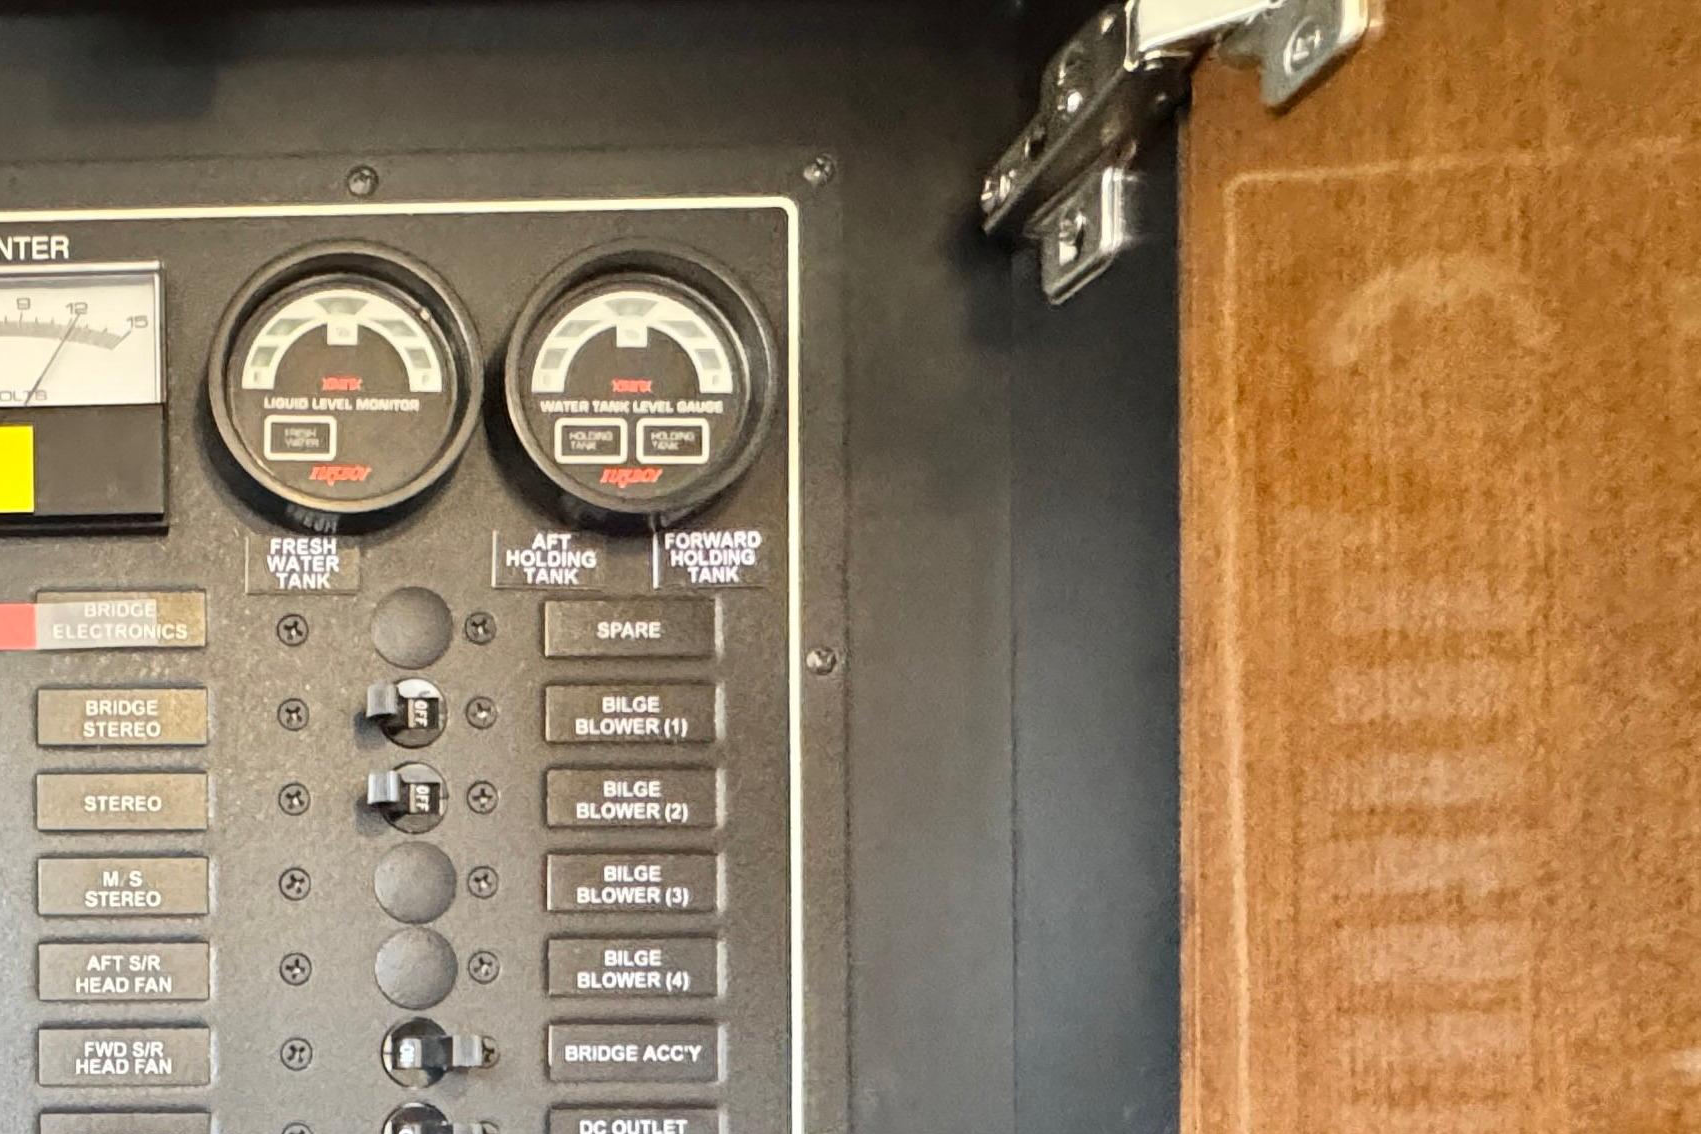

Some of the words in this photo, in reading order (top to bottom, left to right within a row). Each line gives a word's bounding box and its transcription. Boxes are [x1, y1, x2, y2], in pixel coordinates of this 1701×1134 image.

[16, 297, 31, 311] 9
[66, 302, 89, 316] 12
[126, 315, 148, 329] 15
[263, 396, 309, 411] LIQUID
[311, 396, 353, 411] LEVEL
[355, 396, 420, 411] MONITOR
[539, 400, 590, 414] WATER
[591, 400, 630, 414] TANK
[632, 400, 674, 414] LEVEL
[270, 538, 337, 555] FRESH
[532, 533, 573, 550] AFT
[664, 530, 762, 550] FORWARD
[267, 555, 340, 572] WATER
[506, 550, 597, 568] HOLDING
[670, 549, 756, 567] HOLDING
[276, 572, 330, 590] TANK
[524, 567, 579, 585] TANK
[687, 566, 741, 584] TANK
[596, 622, 661, 639] SPARE
[86, 700, 158, 716] BRIDGE
[602, 695, 660, 714] BILGE
[413, 699, 429, 728] OFF
[83, 722, 161, 738] STEREO
[575, 717, 660, 736] BLOWER
[663, 717, 688, 736] (1)
[84, 796, 162, 812] STEREO
[416, 784, 430, 813] OFF
[86, 955, 125, 972] AFT
[128, 955, 161, 972] S/R
[604, 949, 661, 968] BILGE
[75, 977, 130, 993] HEAD
[134, 977, 172, 993] FAN
[576, 971, 661, 991] BLOWER
[665, 971, 691, 991] (4)
[564, 1045, 639, 1063] BRIDGE
[642, 1045, 702, 1063] ACC'Y
